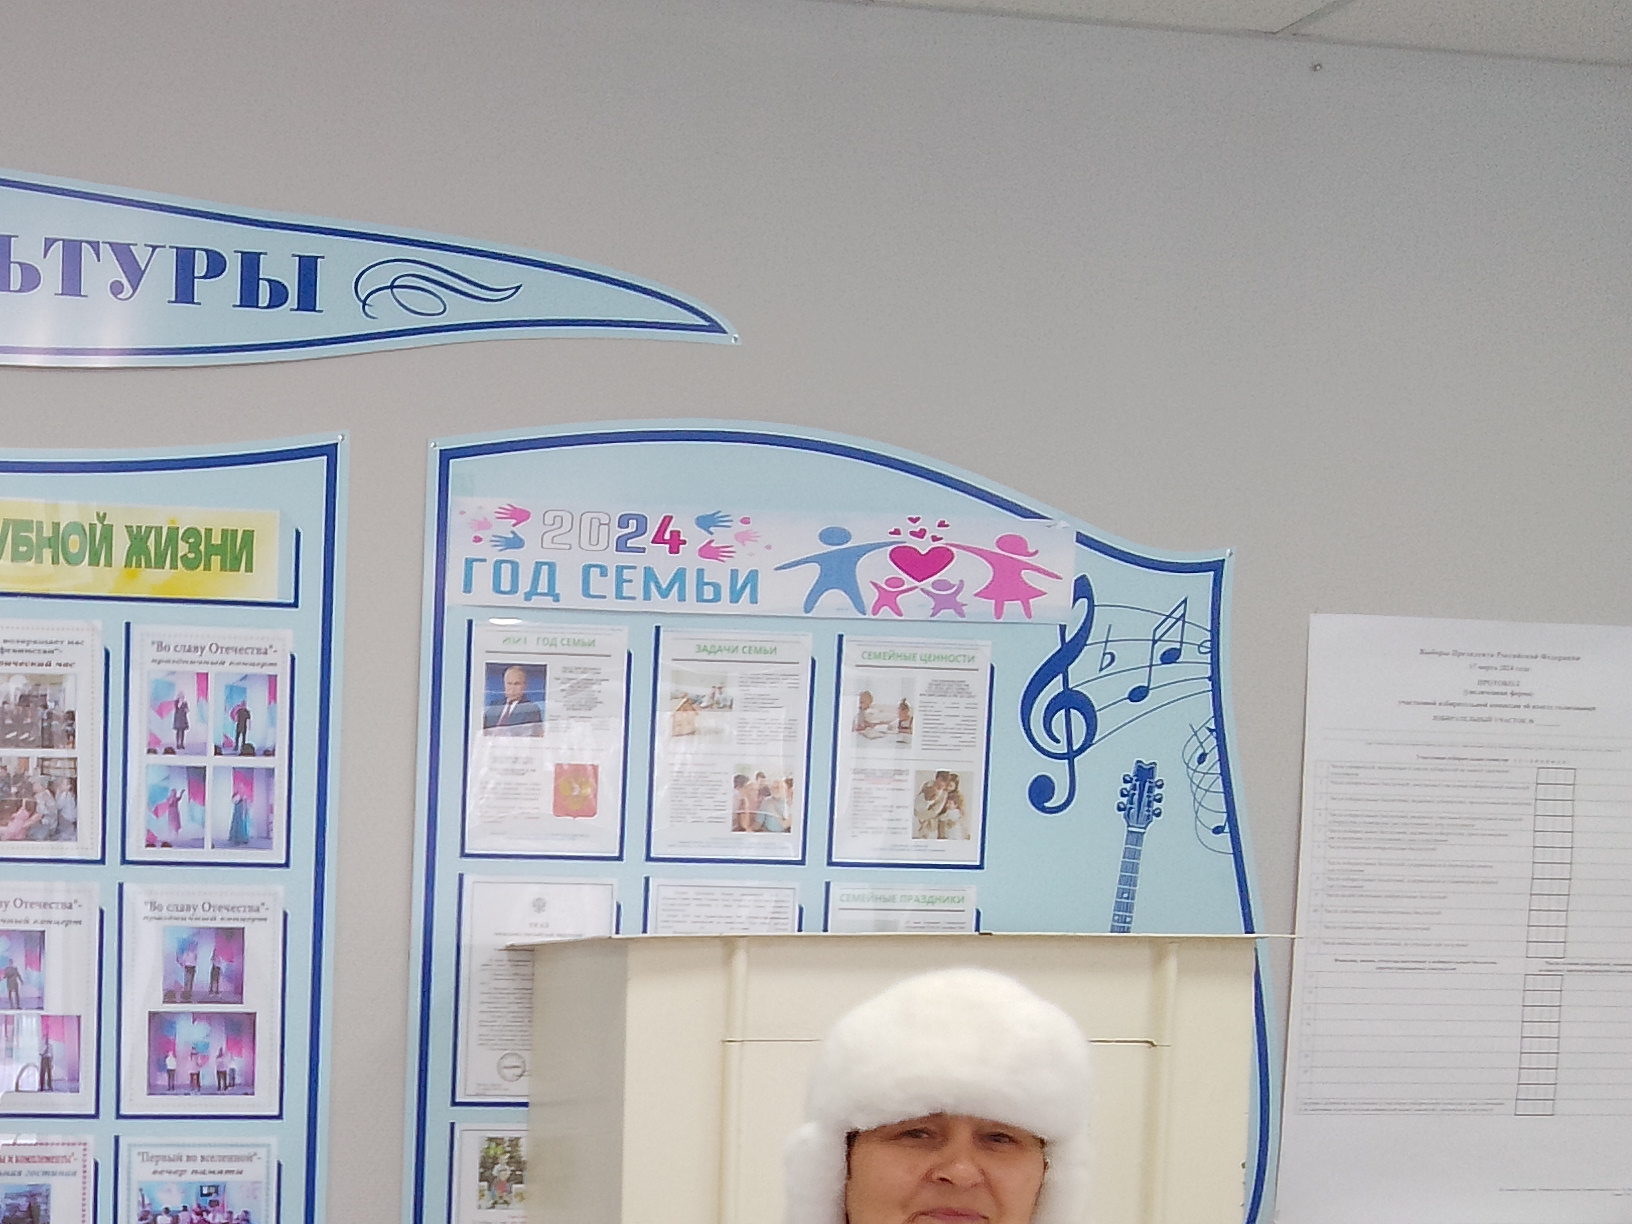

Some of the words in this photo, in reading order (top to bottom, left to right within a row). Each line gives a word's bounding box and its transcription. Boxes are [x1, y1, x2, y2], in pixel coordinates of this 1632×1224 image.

[542, 509, 686, 554] 2024
[124, 525, 255, 573] ЖИЗНИ
[463, 557, 560, 602] ГОД
[581, 563, 759, 605] СЕМЬИ
[561, 637, 597, 648] СЕМЬИ
[695, 644, 739, 656] ЗАДАЧИ
[742, 645, 777, 655] СЕМЬИ
[861, 650, 917, 661] СЕМЕЙНЫЕ
[919, 652, 975, 664] ЦЕННОСТИ
